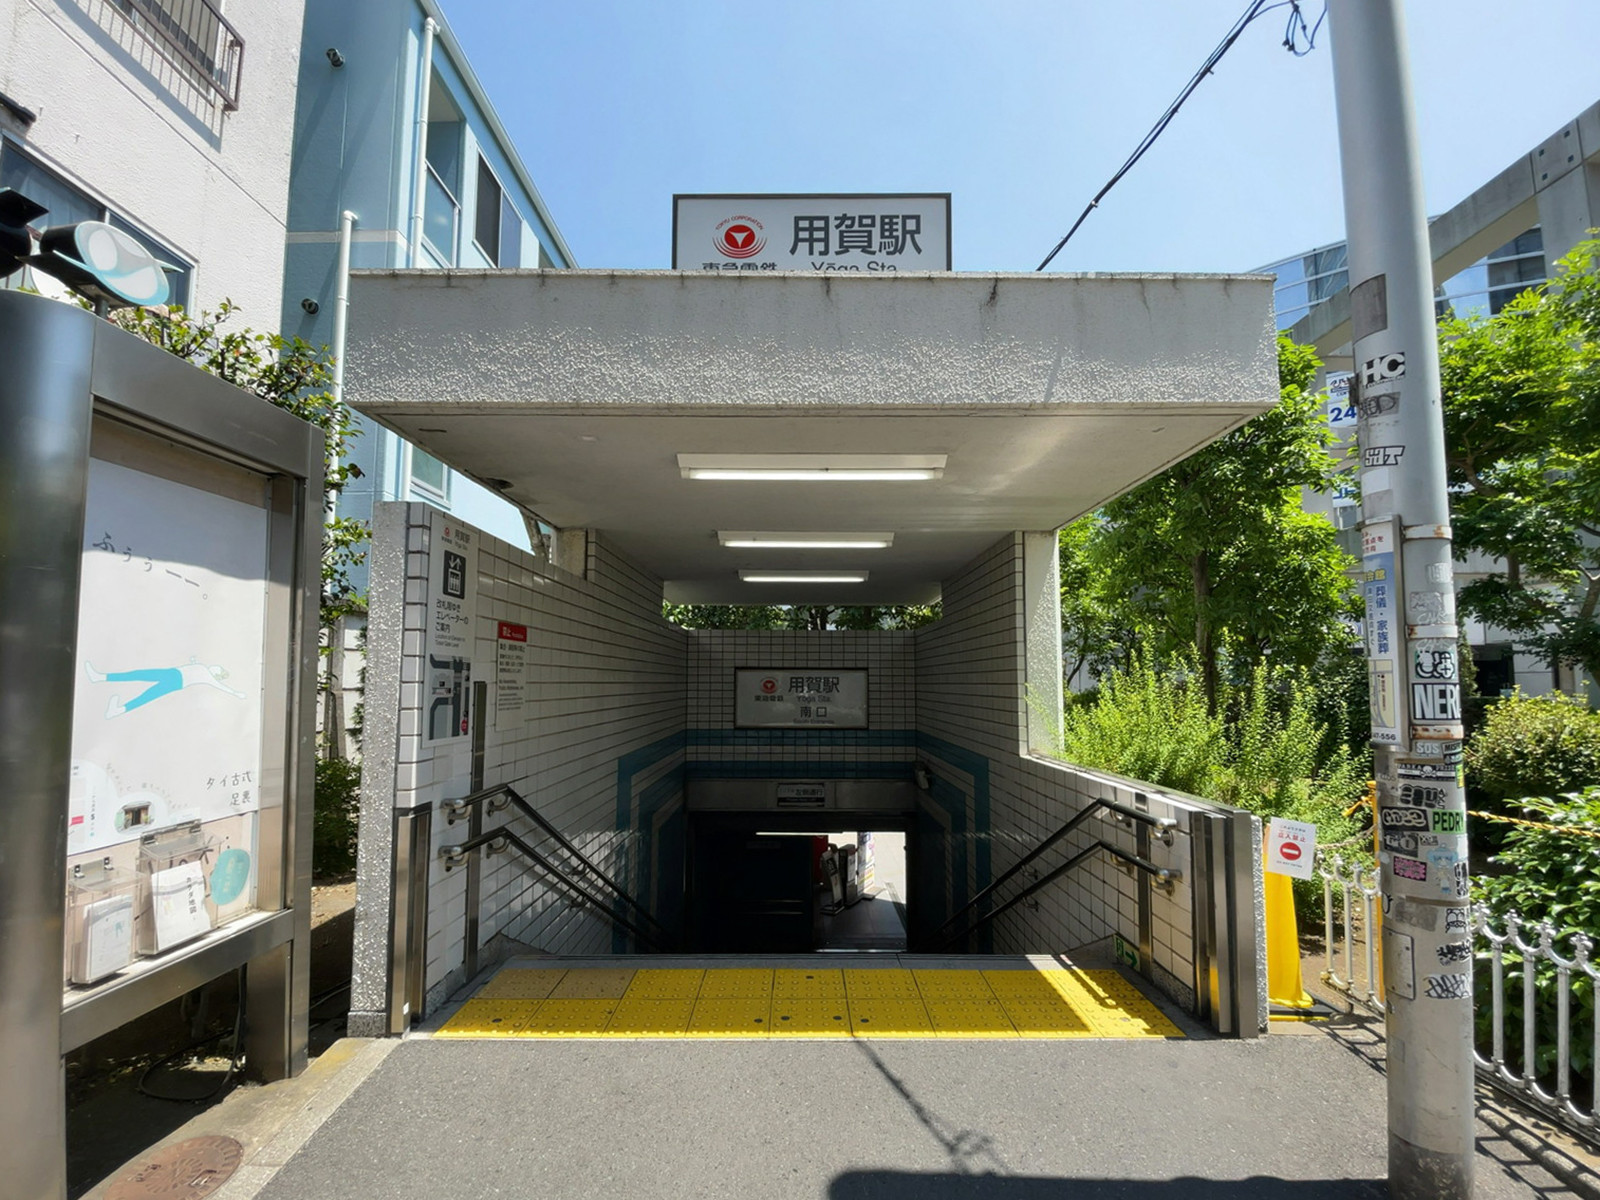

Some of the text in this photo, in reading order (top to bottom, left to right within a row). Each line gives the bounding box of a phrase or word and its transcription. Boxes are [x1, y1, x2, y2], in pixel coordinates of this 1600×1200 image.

[788, 213, 923, 256] 用賀駅
[1330, 406, 1357, 422] 24
[788, 676, 840, 693] 用賀駅
[1416, 742, 1439, 754] SOS
